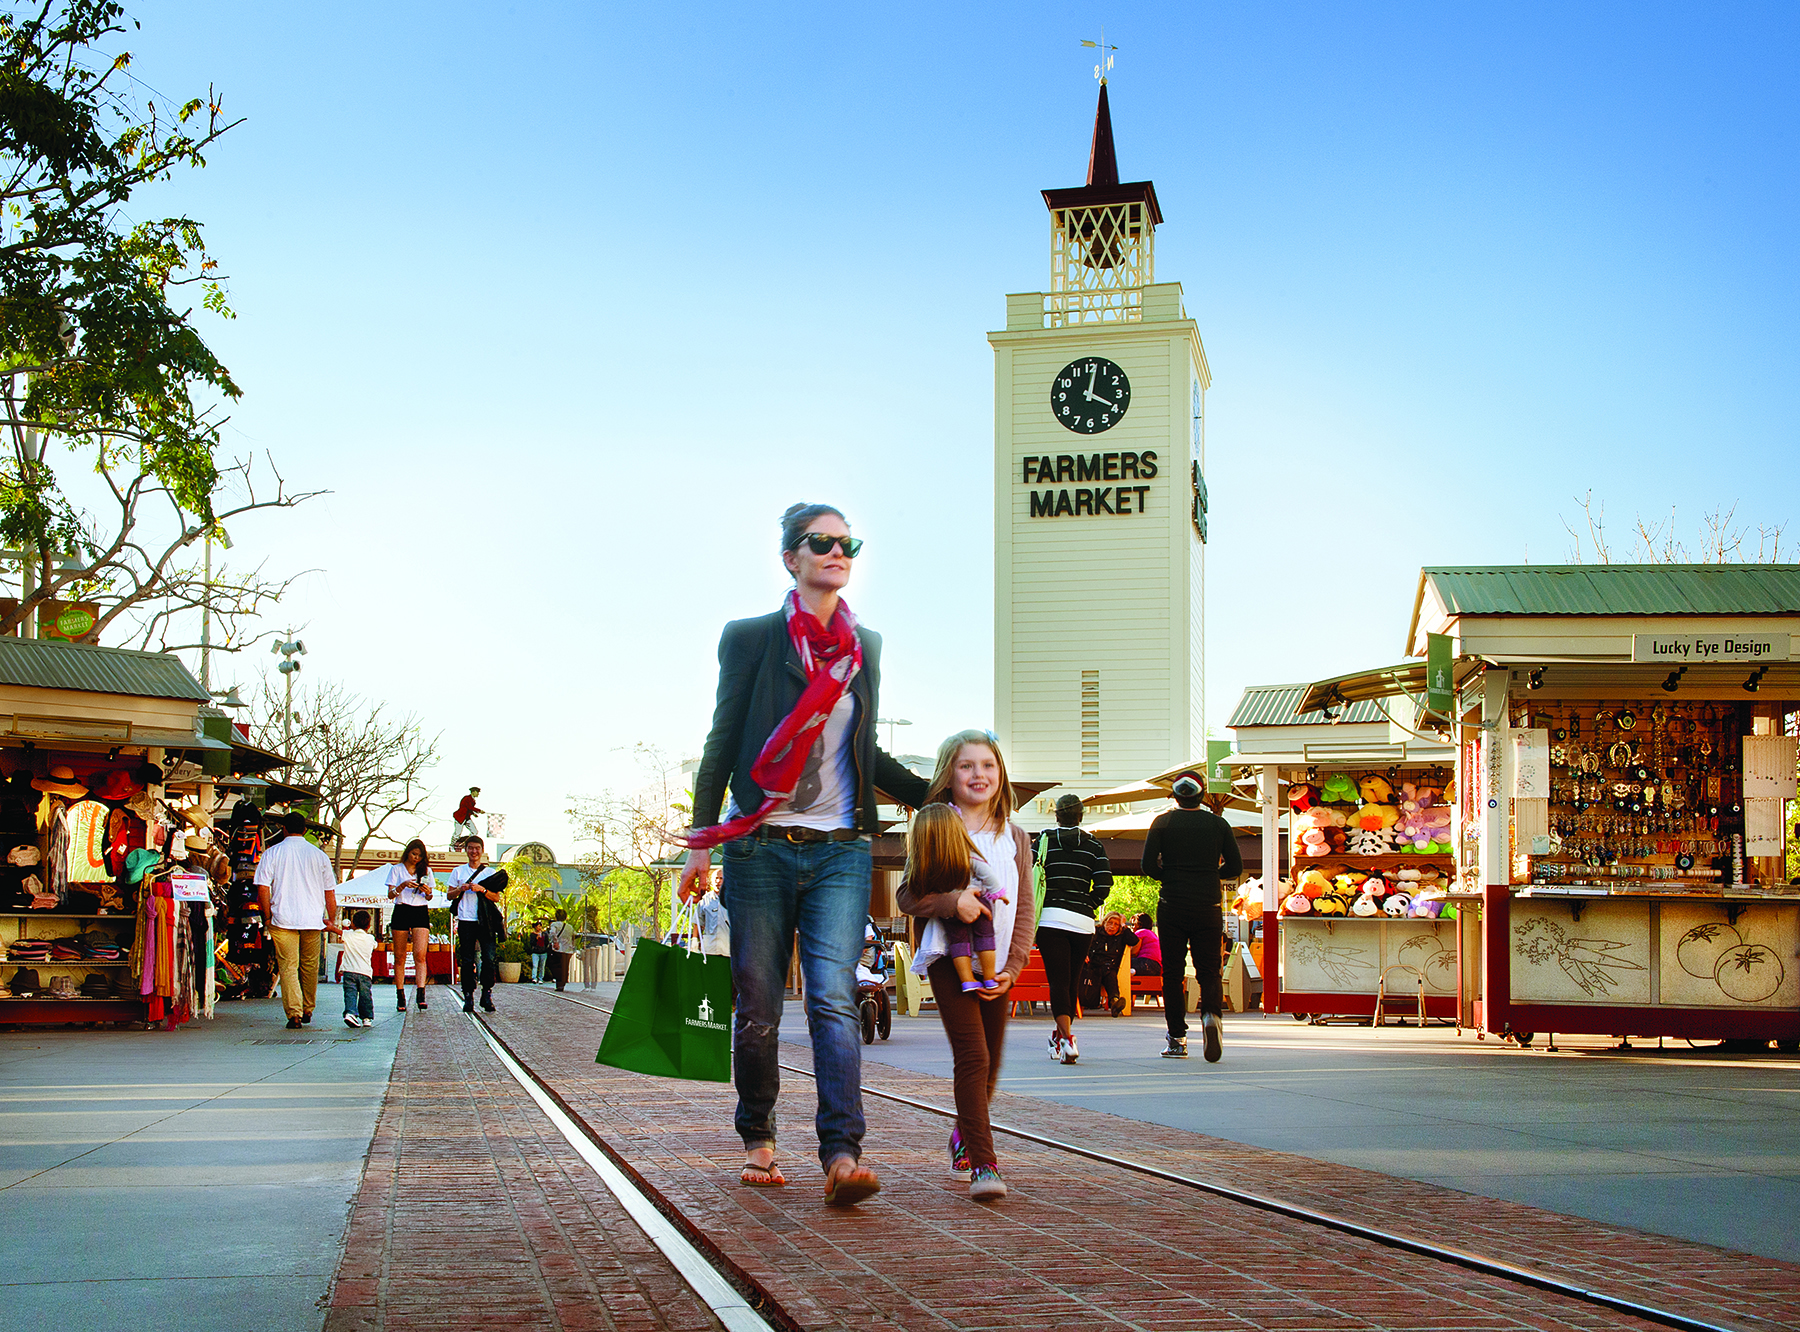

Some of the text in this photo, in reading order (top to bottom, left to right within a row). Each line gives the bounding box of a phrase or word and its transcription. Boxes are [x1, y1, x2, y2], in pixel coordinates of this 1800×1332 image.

[1073, 367, 1081, 377] 11
[1085, 363, 1097, 373] 12
[1103, 366, 1107, 375] 1
[1061, 378, 1072, 388] 10
[1111, 375, 1119, 386] 2
[1059, 392, 1066, 402] 9
[1115, 389, 1123, 399] 3
[1062, 406, 1070, 415] 8
[1111, 404, 1119, 413] 4
[1073, 415, 1081, 425] 7
[1086, 418, 1094, 428] 6
[1101, 413, 1109, 423] 5
[1023, 450, 1158, 483] FARMERS
[1030, 485, 1151, 518] MARKET
[60, 615, 89, 626] FARMERS
[63, 621, 89, 632] MARKET
[1652, 639, 1771, 657] Lucky Eye Design
[1034, 798, 1131, 814] TAHEN
[376, 851, 446, 860] GILRE
[685, 1017, 727, 1031] FARMERS MARKET
